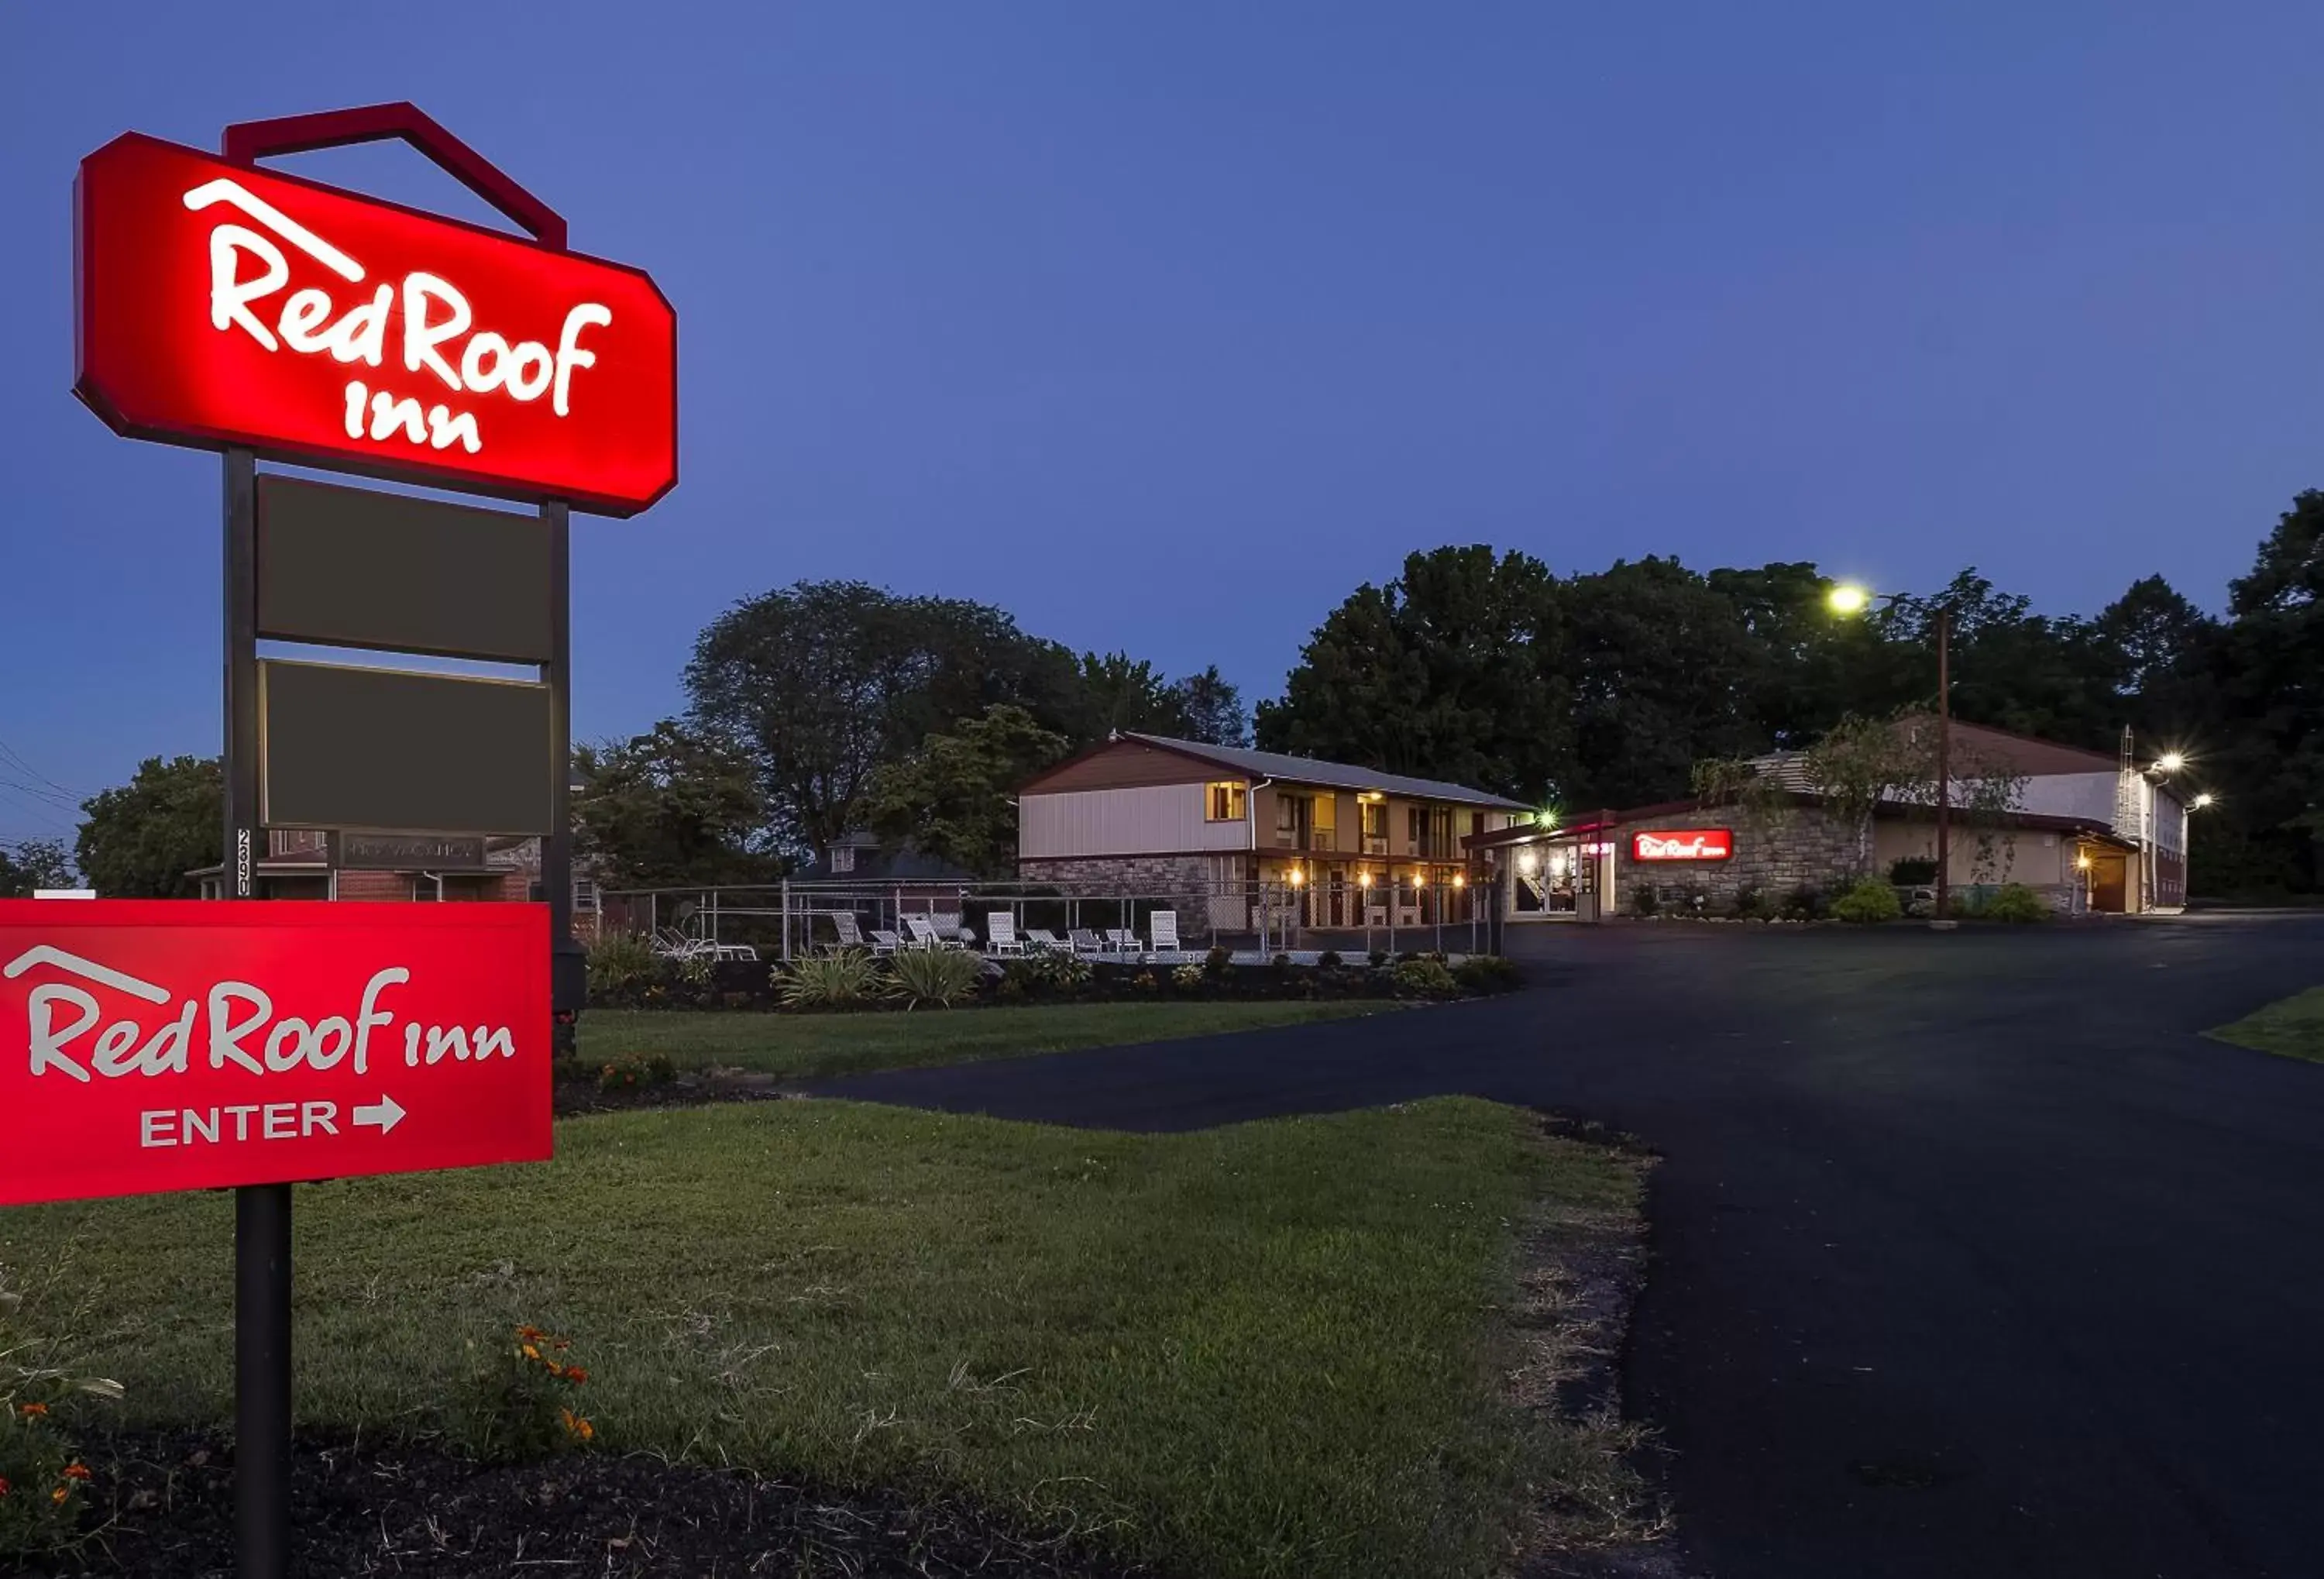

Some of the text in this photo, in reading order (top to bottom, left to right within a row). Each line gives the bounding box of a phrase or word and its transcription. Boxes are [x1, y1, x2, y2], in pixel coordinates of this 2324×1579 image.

[239, 830, 249, 894] 2390
[1666, 837, 1704, 857] Rf
[141, 1100, 339, 1148] ENTER
